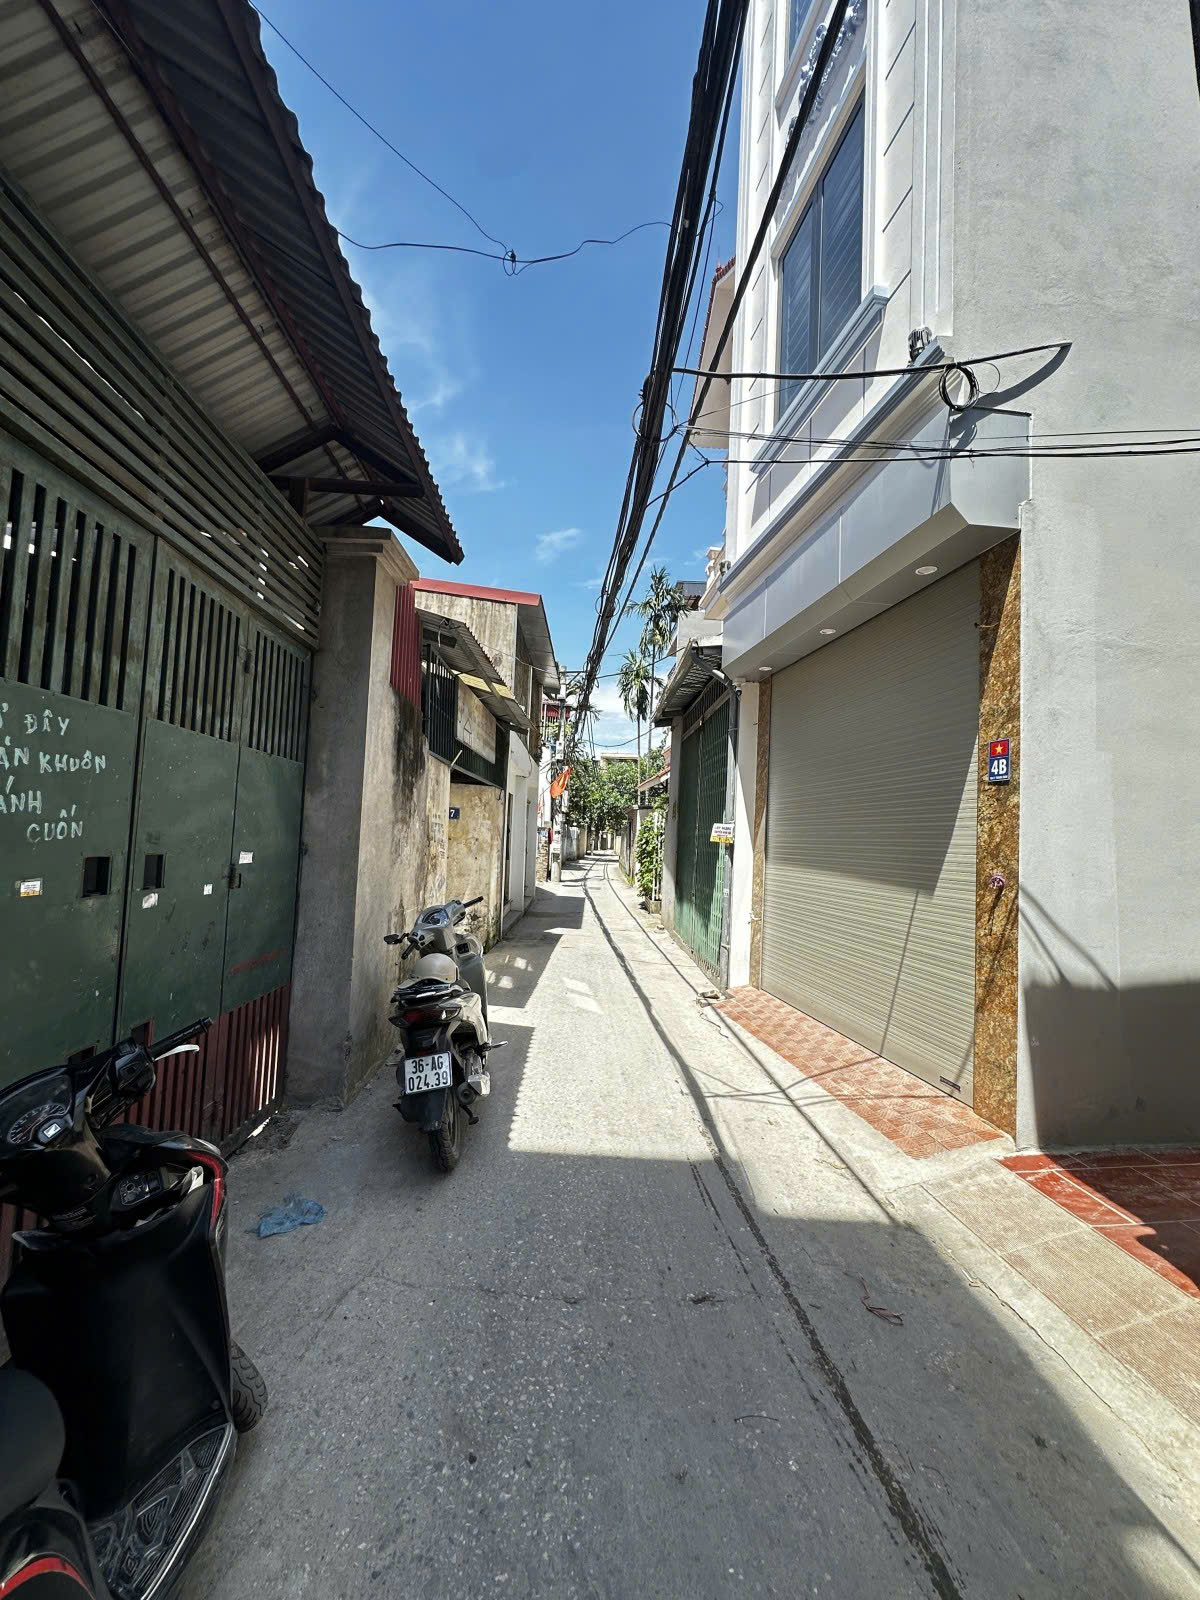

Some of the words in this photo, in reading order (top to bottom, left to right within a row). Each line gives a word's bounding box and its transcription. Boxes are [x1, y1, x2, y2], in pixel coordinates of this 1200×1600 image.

[24, 709, 70, 736] ĐÂY
[991, 759, 1007, 775] 4B
[411, 1055, 443, 1074] 36-AG
[408, 1071, 448, 1091] 024.39
